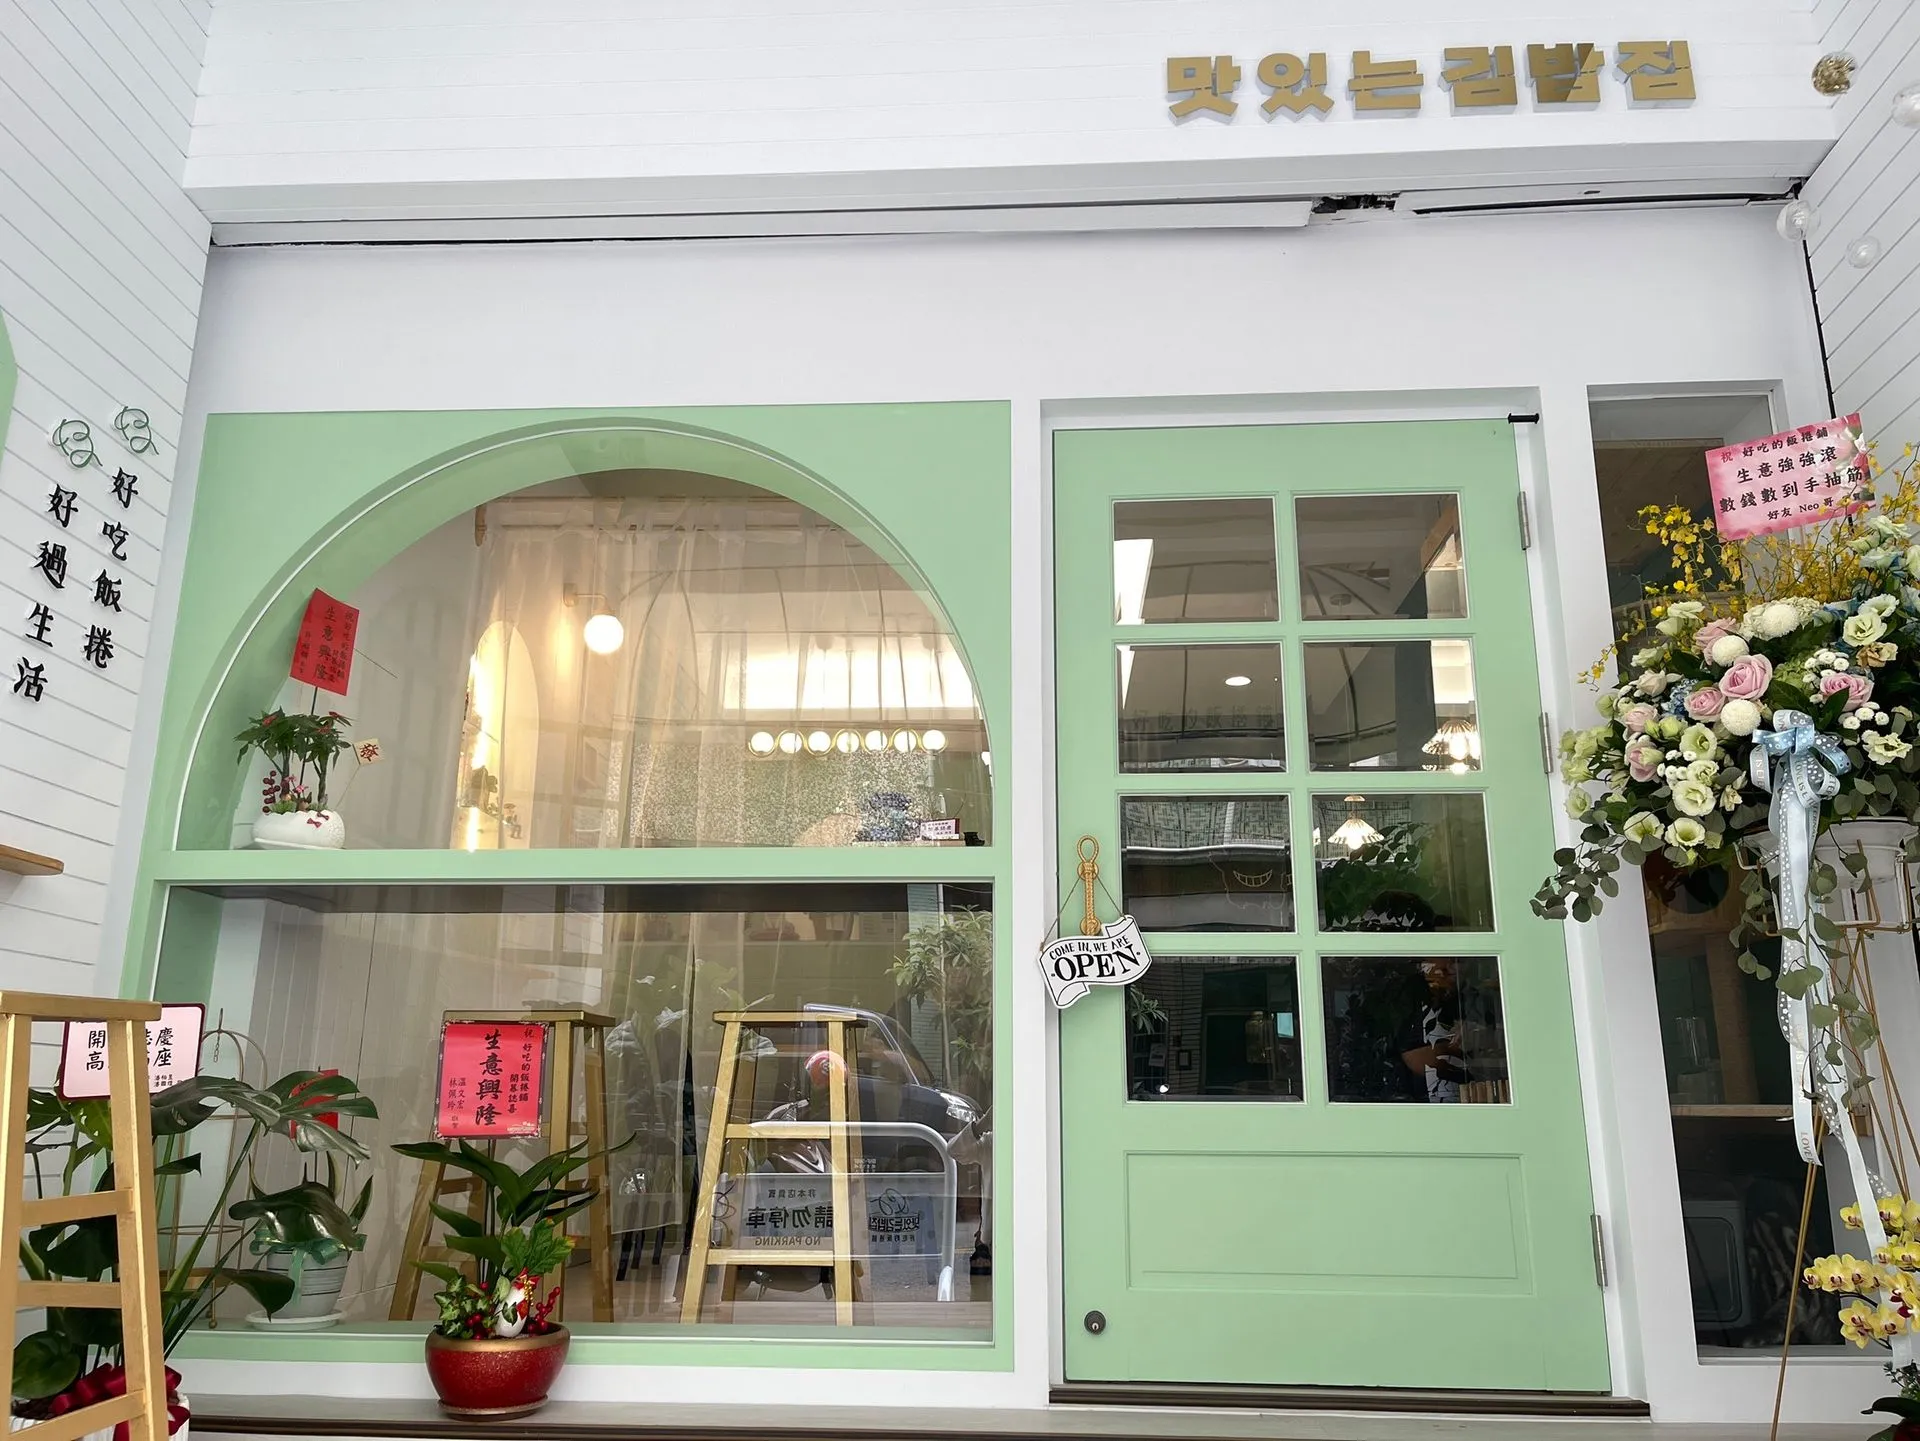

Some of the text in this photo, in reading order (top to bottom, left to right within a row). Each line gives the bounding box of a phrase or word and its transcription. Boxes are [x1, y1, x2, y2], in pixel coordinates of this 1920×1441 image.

[1166, 40, 1697, 122] 맛있는김밥집
[1720, 426, 1829, 464] 祝 好吃的飯捲鋪
[1737, 446, 1838, 484] 生意強強滾
[1719, 466, 1863, 513] 數錢數到手抽筋
[1767, 507, 1793, 520] 好友
[1799, 503, 1820, 513] Neo
[1823, 496, 1834, 508] 哥
[83, 466, 138, 668] 好吃飯捲
[13, 483, 79, 702] 好過生活
[314, 605, 337, 680] 生意興隆
[1049, 935, 1130, 960] COME IN, WE ARE
[1054, 944, 1141, 982] OPEN
[475, 1028, 503, 1126] 生意興隆
